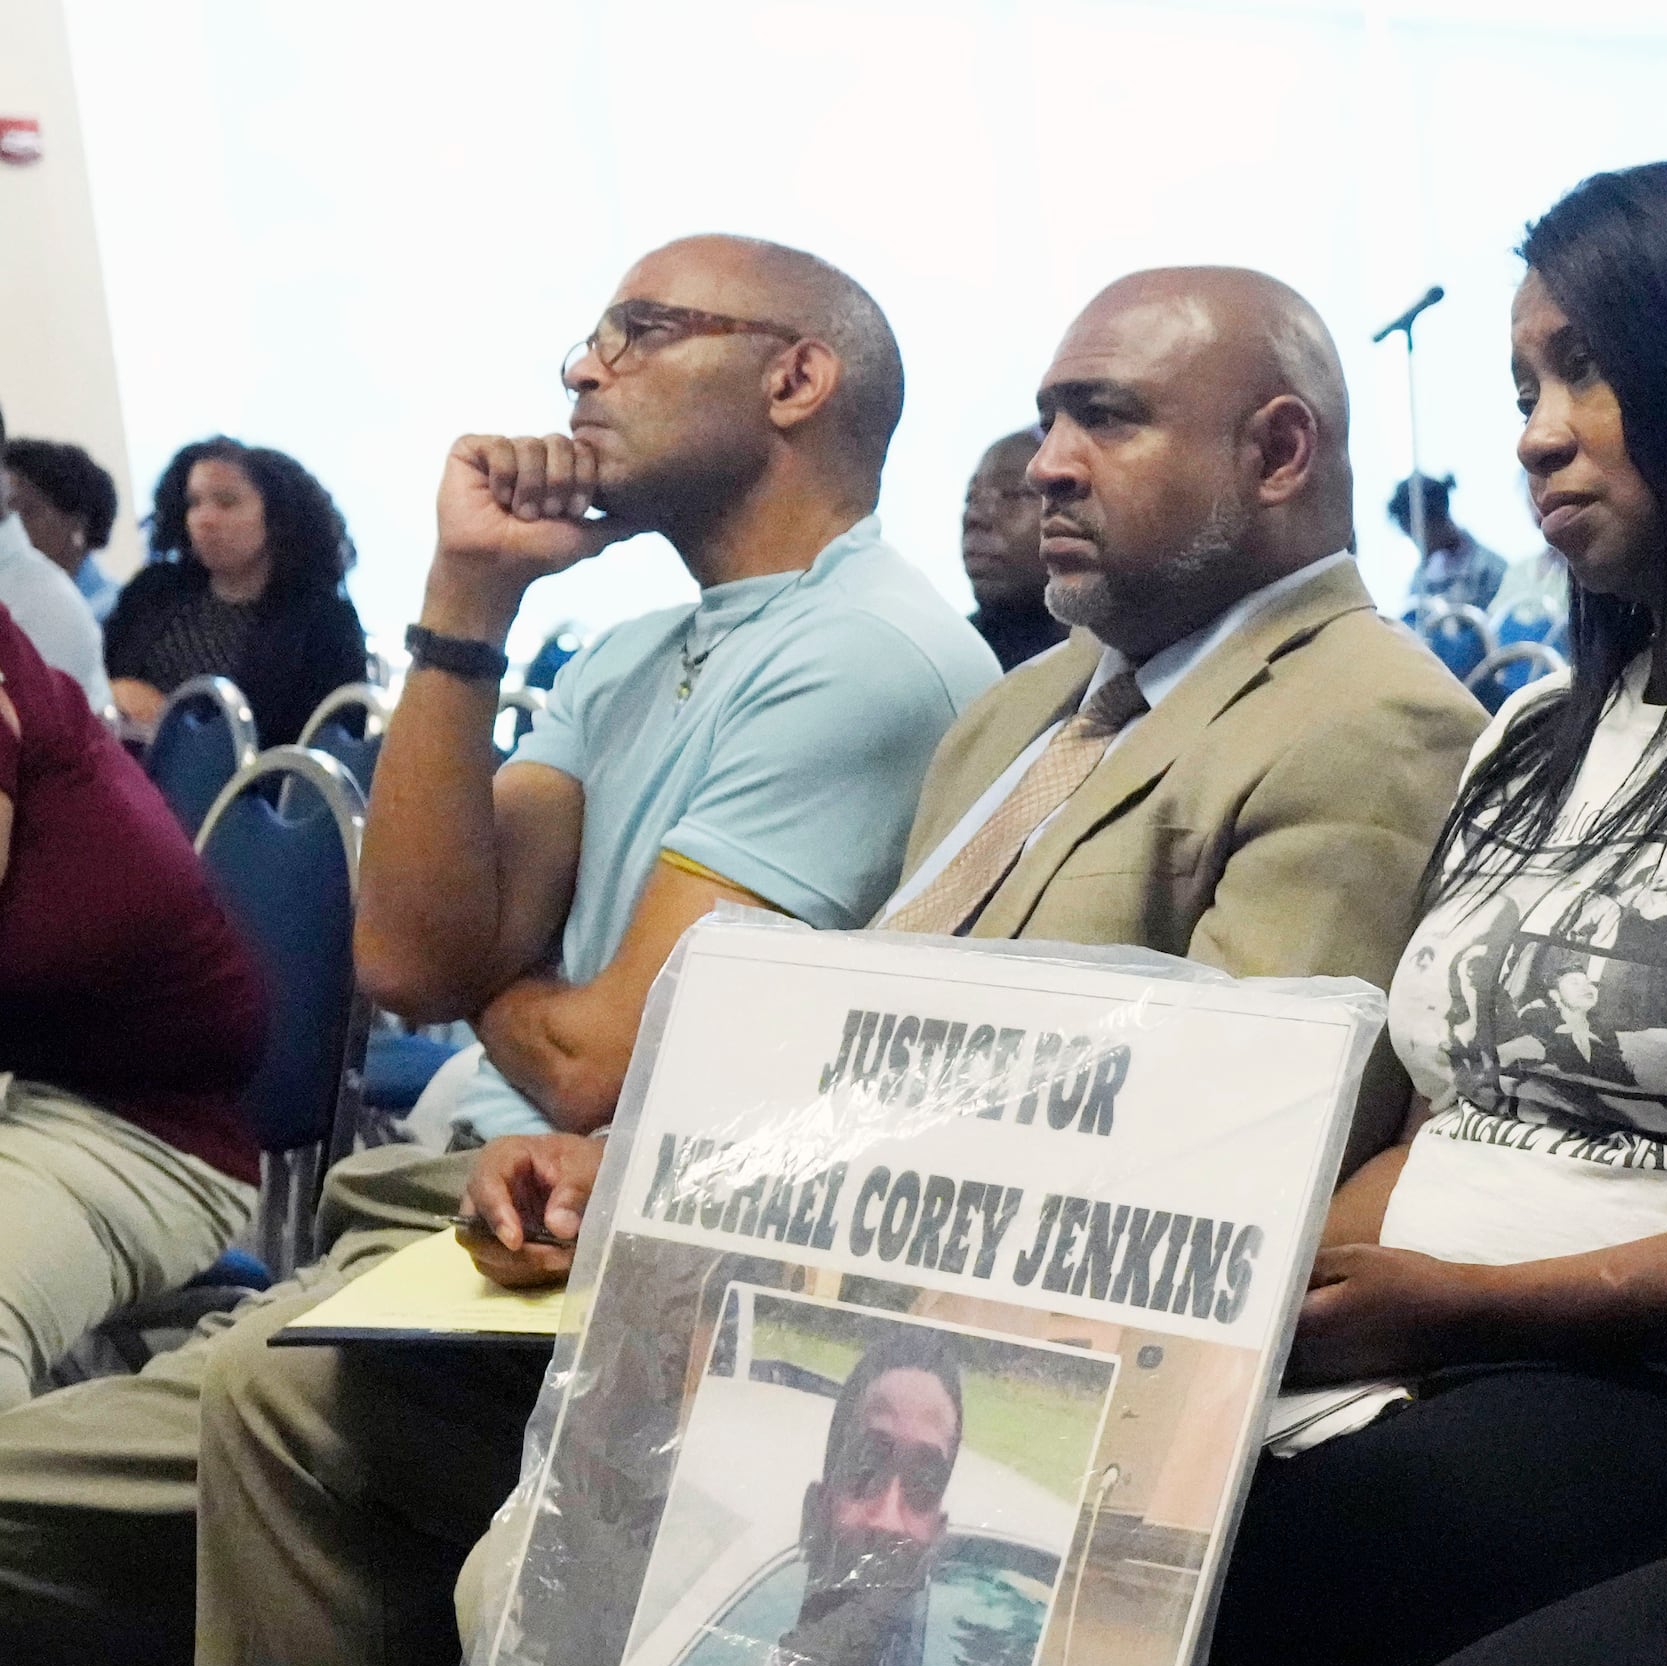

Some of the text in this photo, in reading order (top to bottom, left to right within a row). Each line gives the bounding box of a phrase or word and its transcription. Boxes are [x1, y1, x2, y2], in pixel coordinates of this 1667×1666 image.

[818, 1008, 1131, 1137] JUSTICE FOR
[848, 1165, 1025, 1280] COREY
[1013, 1194, 1265, 1325] JENKINS
